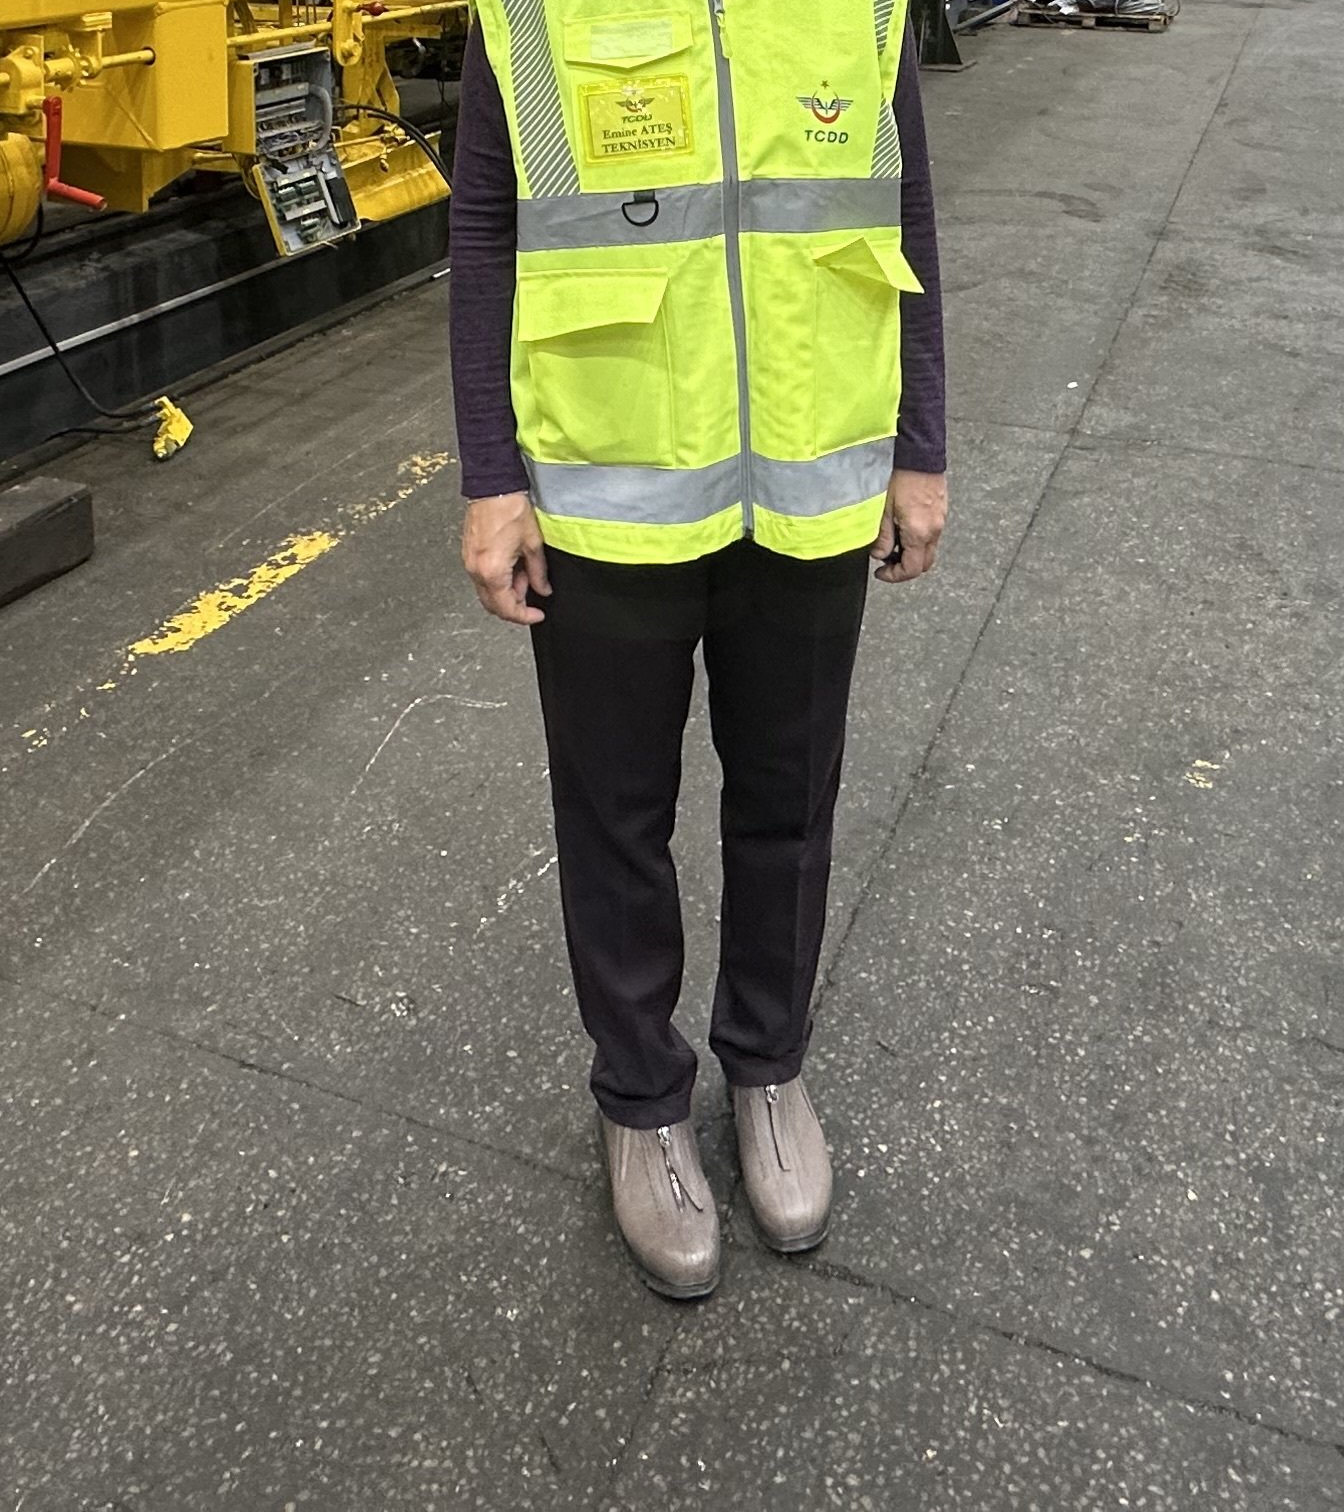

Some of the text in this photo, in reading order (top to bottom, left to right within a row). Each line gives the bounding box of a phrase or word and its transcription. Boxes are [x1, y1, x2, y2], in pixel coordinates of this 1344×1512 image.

[602, 123, 673, 140] Emine ATEŞ
[804, 129, 849, 144] TCDD
[601, 136, 676, 154] TEKNİSYEN
